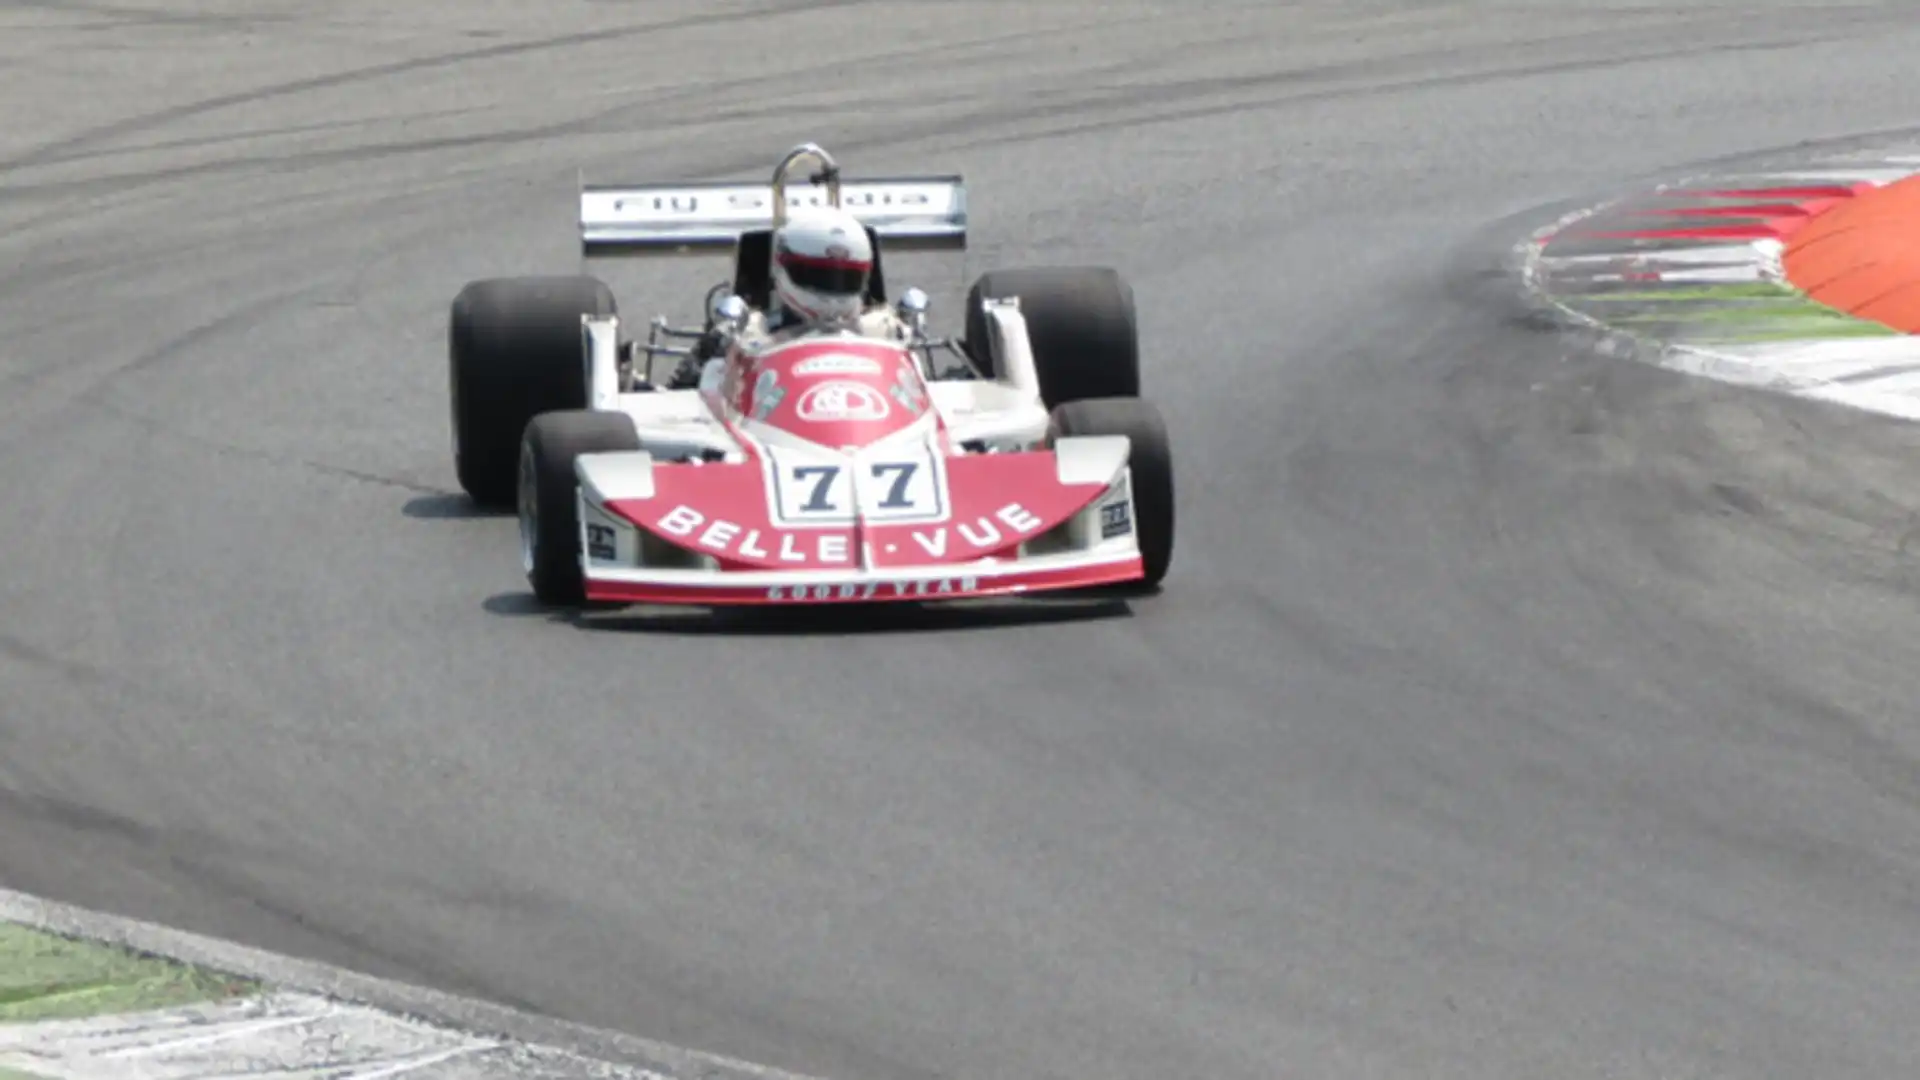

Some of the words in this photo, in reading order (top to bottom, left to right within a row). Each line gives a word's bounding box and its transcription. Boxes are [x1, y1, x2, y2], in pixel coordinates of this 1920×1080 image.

[613, 195, 698, 213] Fly
[656, 504, 849, 563] BELLE
[911, 502, 1043, 558] VUE
